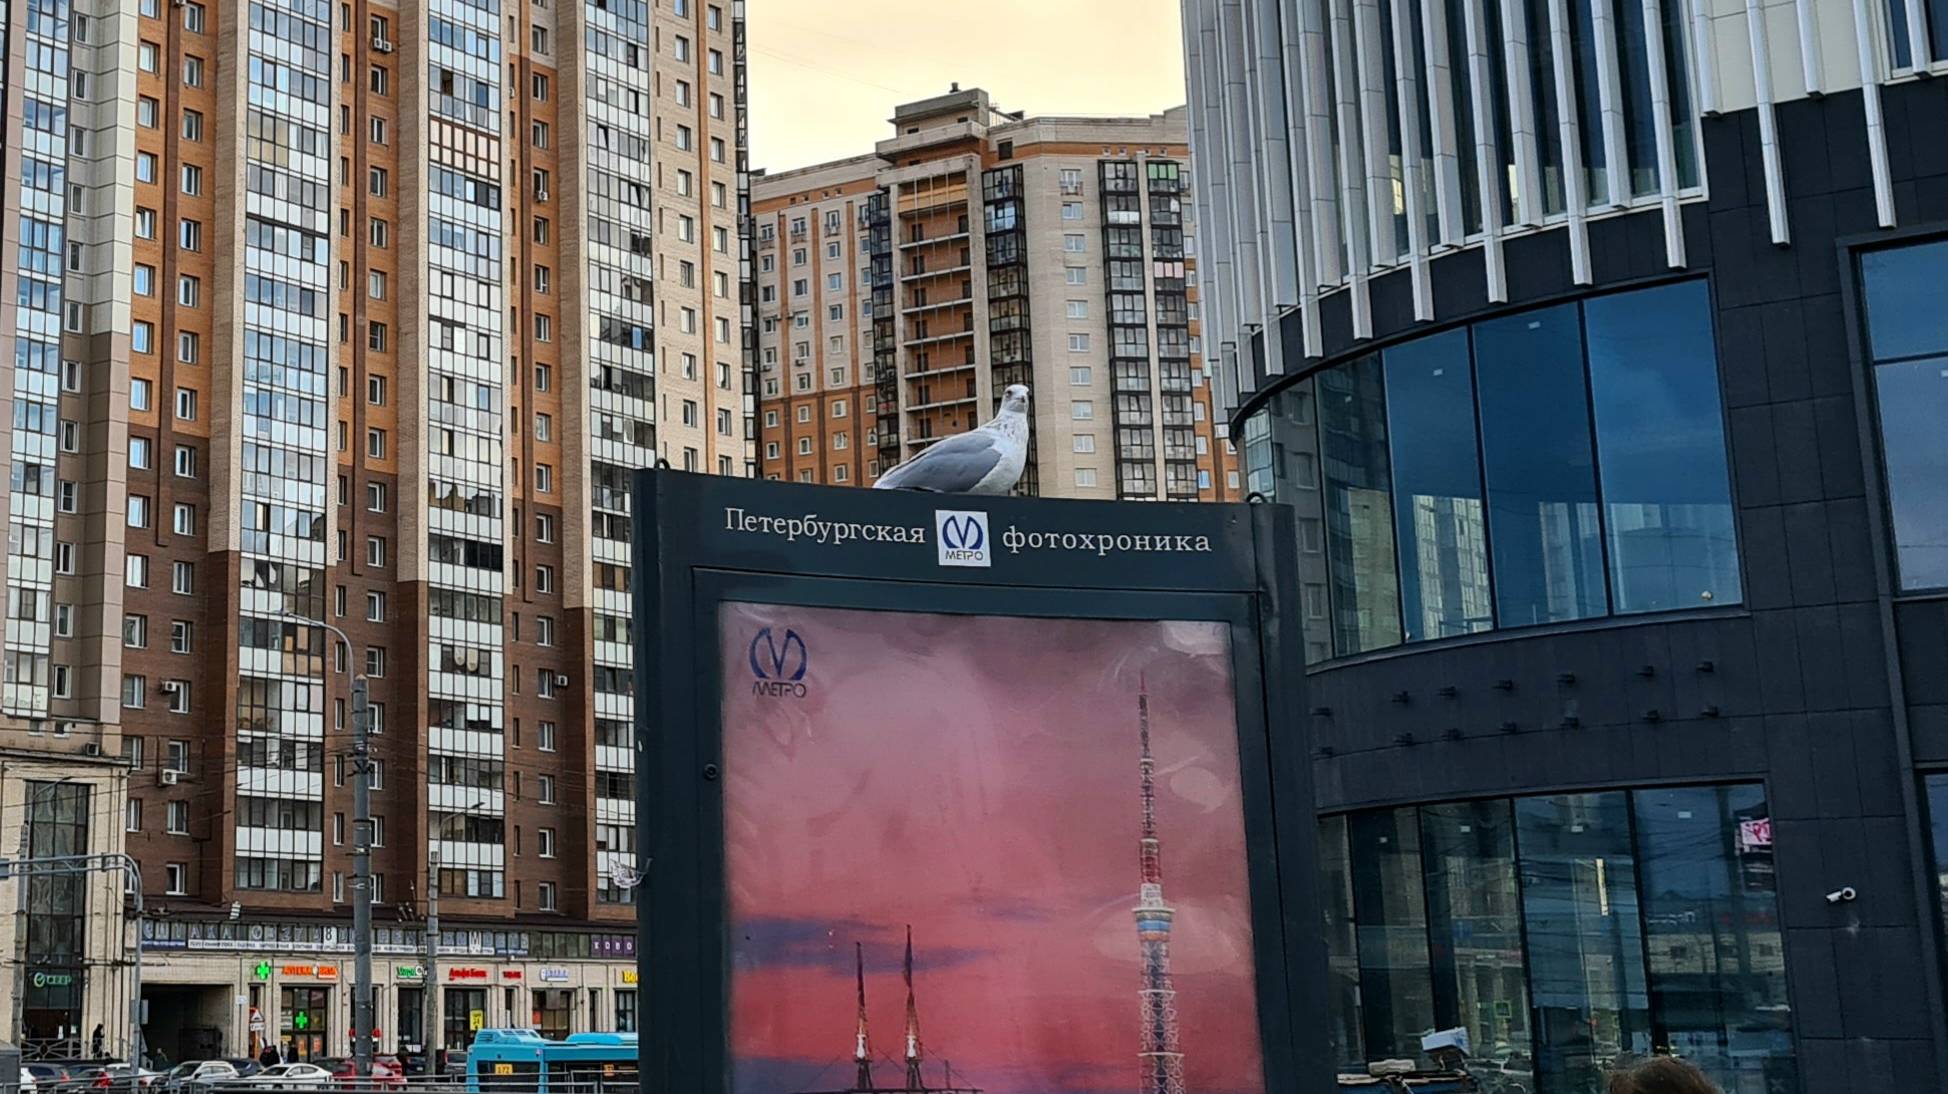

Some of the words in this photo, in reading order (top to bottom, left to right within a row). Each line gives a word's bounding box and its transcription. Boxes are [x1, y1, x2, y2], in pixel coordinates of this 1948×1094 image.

[725, 507, 926, 544] Петербургская
[1002, 525, 1212, 558] фотохроника
[944, 550, 983, 561] МЕТРО
[752, 682, 806, 698] МЕТРО
